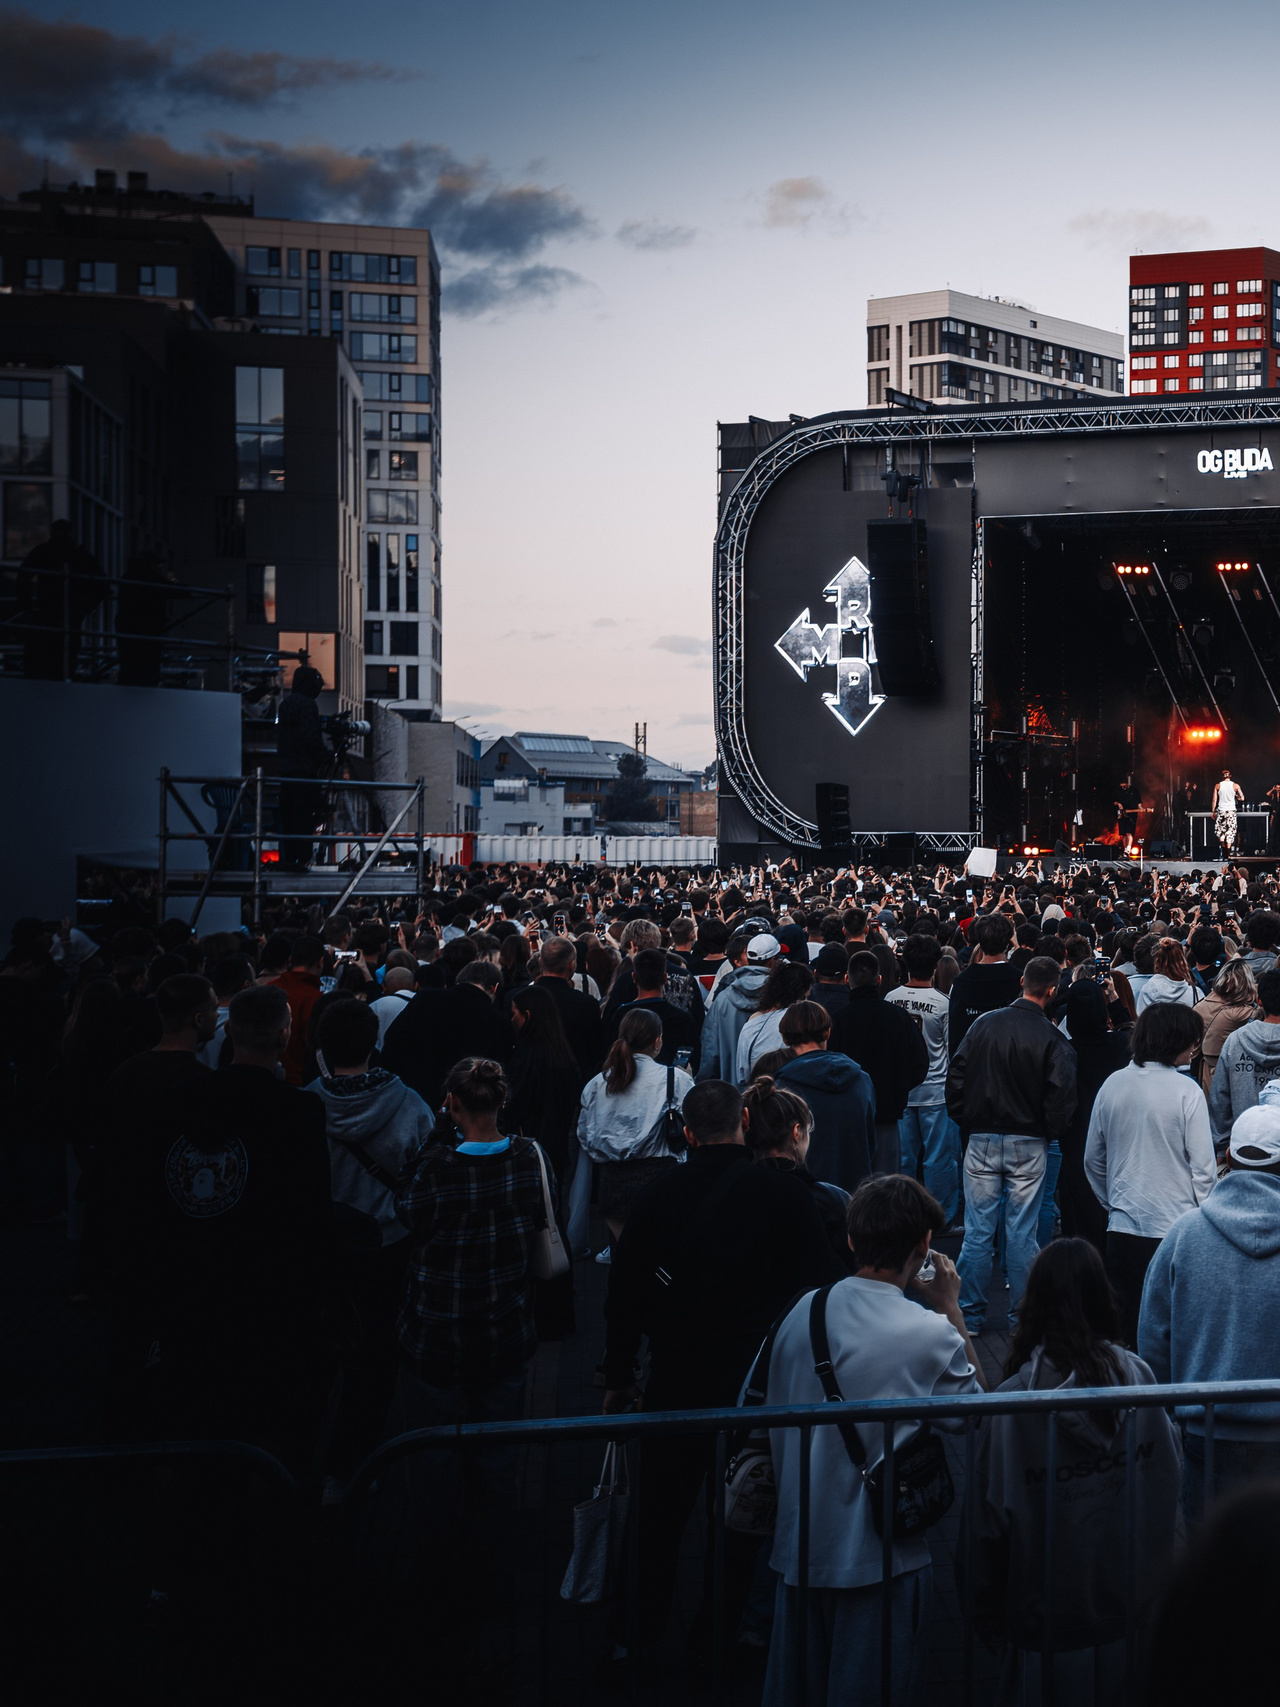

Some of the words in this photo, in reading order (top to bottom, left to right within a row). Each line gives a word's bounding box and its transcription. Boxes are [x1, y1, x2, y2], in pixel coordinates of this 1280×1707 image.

[1197, 449, 1223, 473] OG
[1223, 447, 1274, 472] BUDA
[911, 1001, 934, 1014] YAMAL
